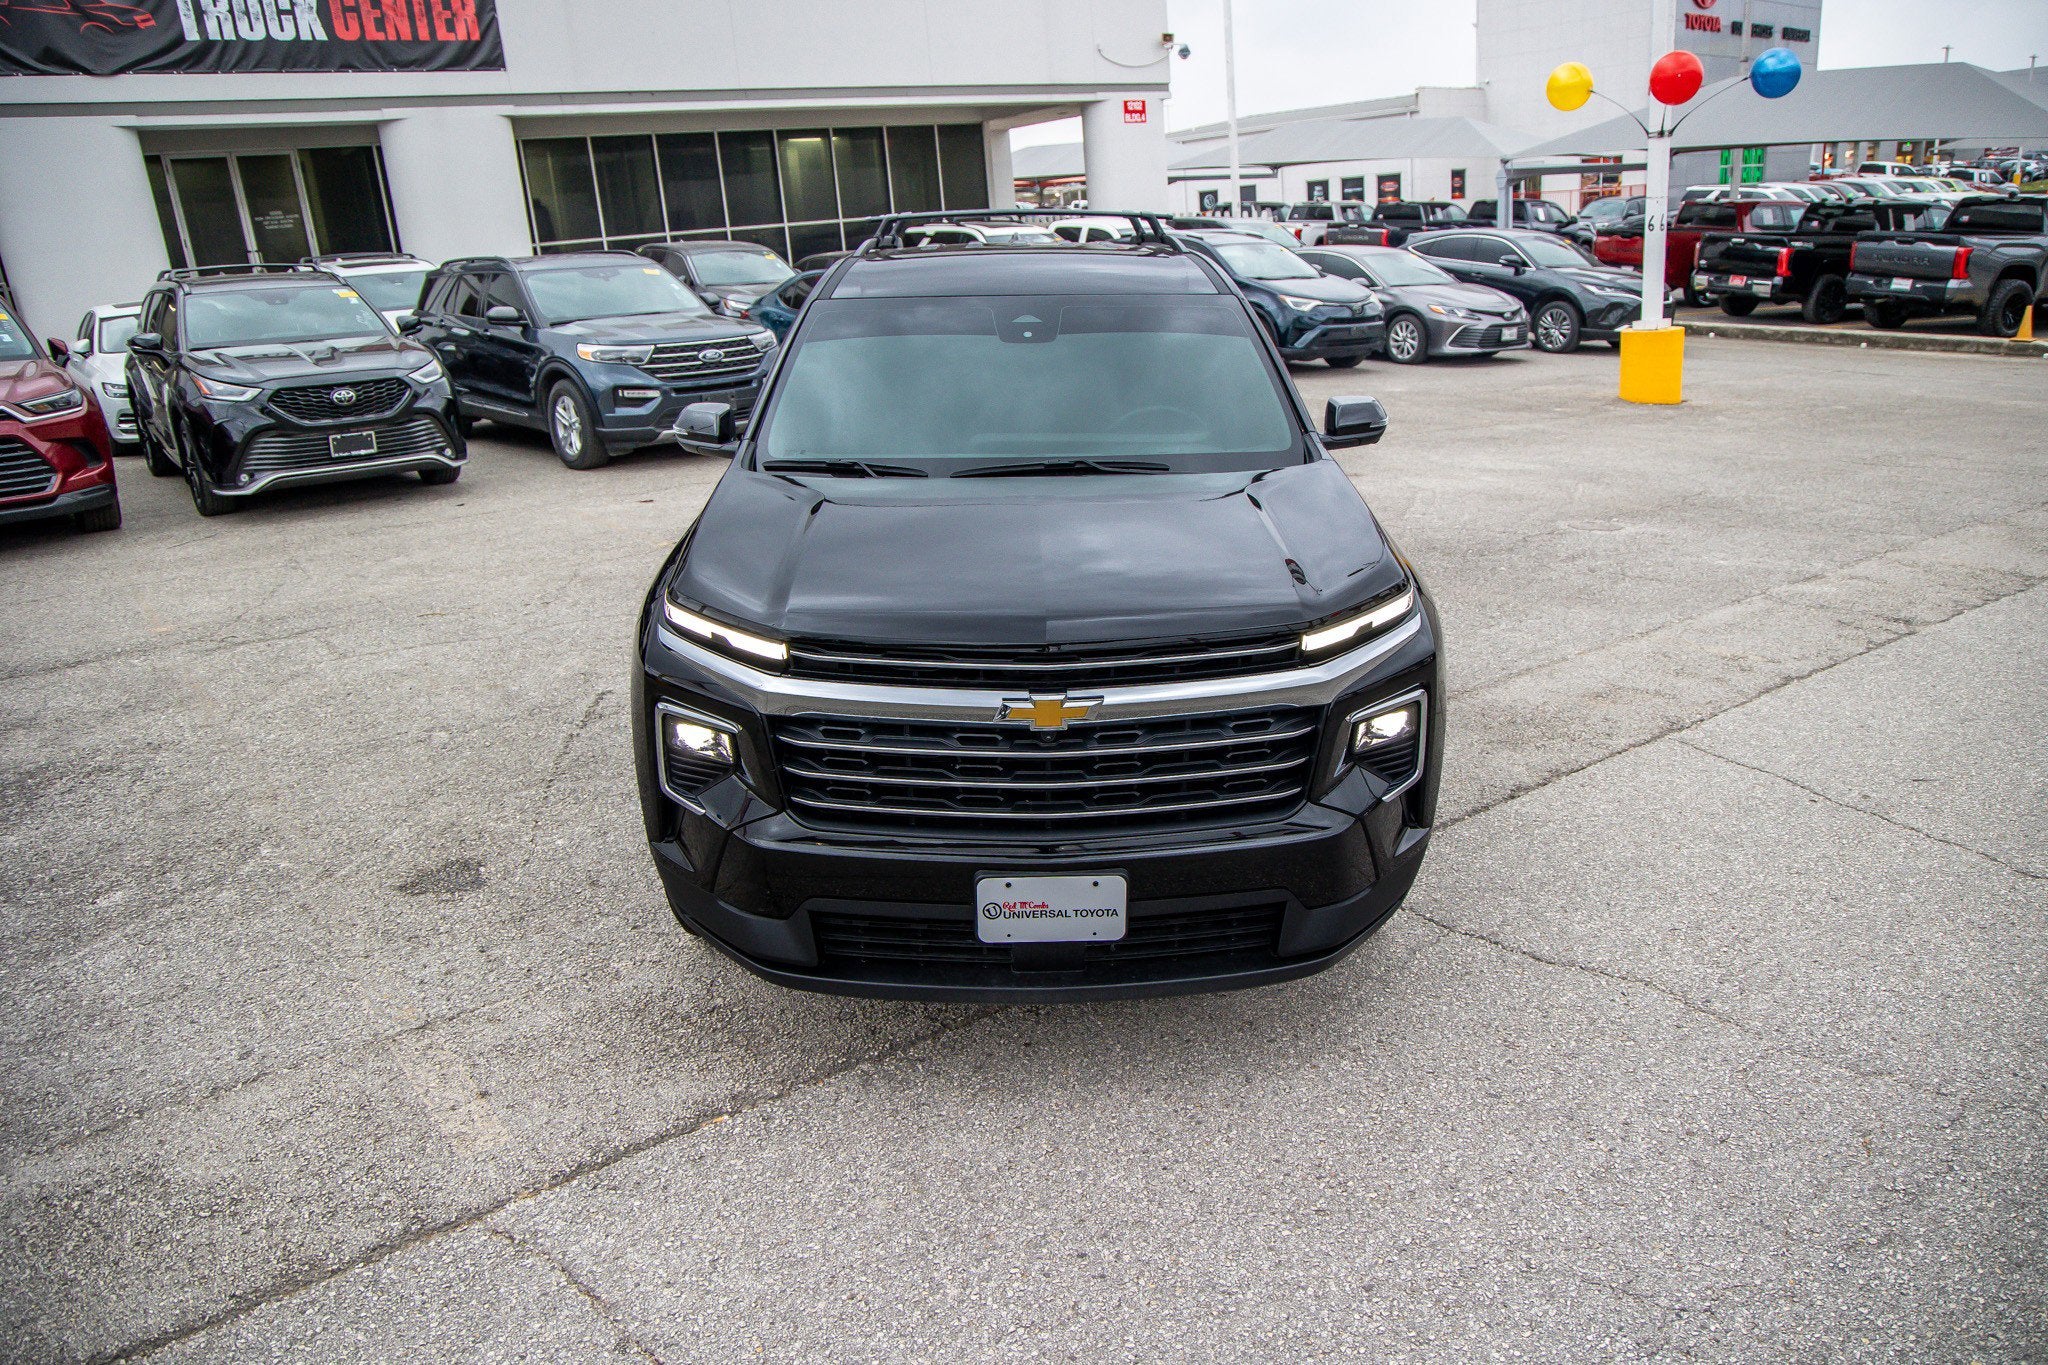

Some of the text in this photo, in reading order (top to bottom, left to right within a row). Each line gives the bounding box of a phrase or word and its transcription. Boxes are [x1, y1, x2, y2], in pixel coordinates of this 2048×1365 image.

[176, 0, 481, 41] TRUCK CENTER
[1685, 12, 1722, 33] TOYOTA
[1003, 908, 1119, 920] UNIVERSAL TOYOTA
